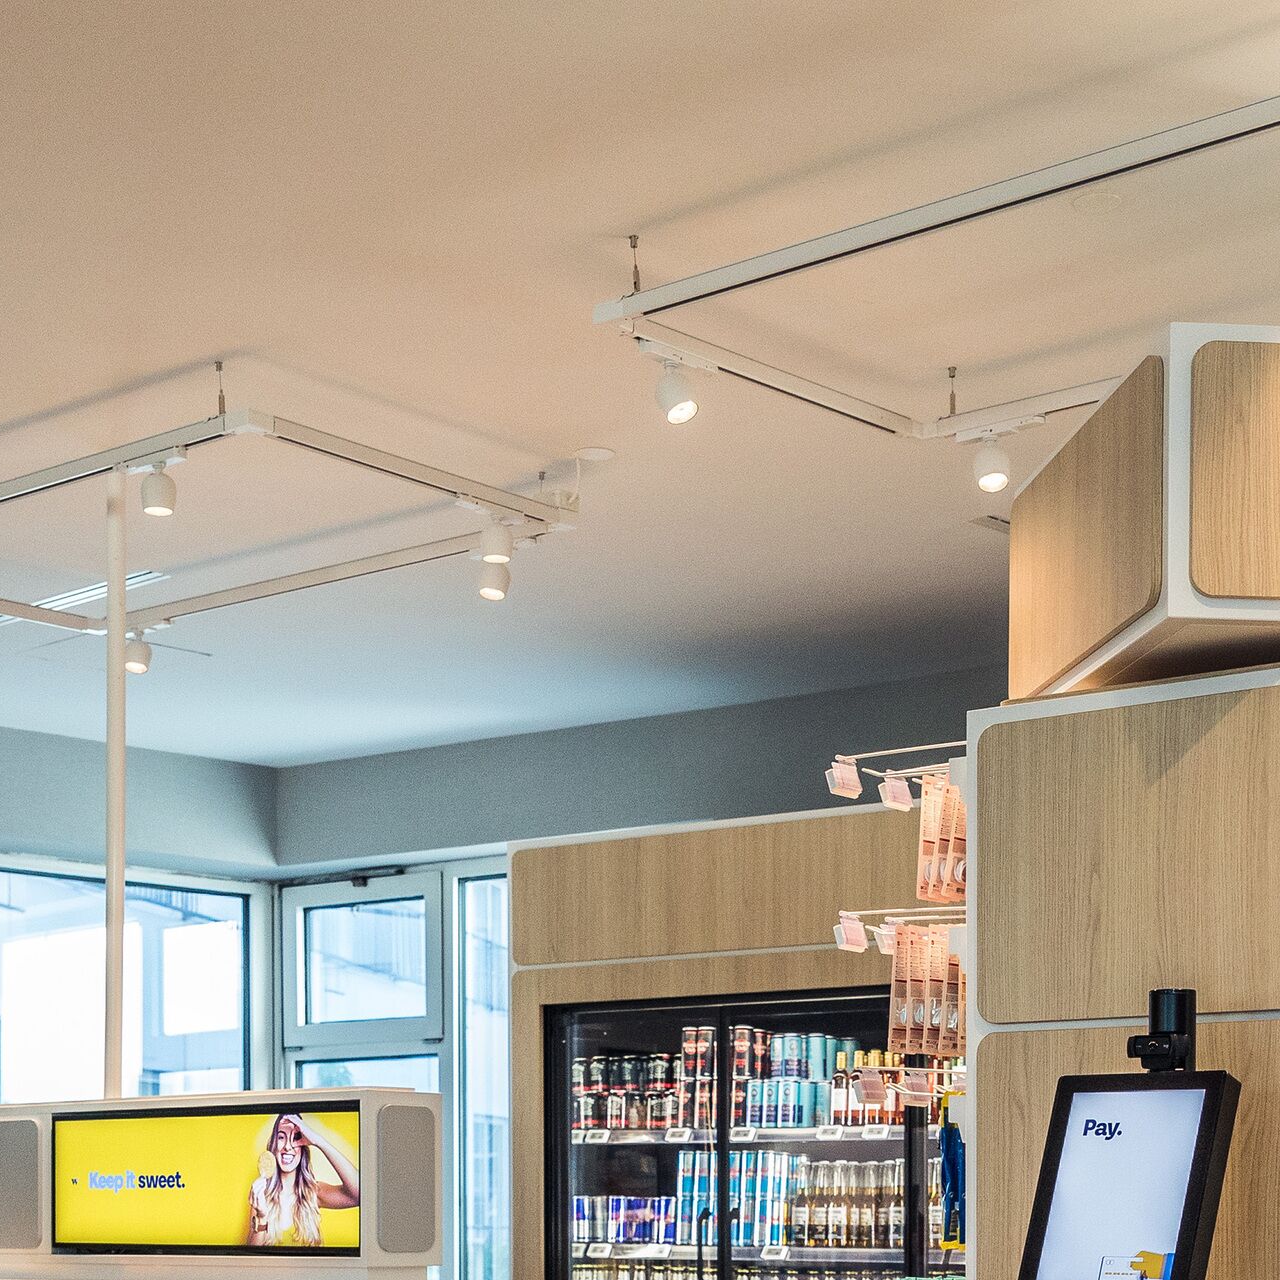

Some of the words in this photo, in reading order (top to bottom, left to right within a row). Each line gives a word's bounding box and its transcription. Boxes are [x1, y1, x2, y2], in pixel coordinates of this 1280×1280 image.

[1082, 1117, 1123, 1140] Pay.
[88, 1170, 124, 1193] Keep
[125, 1170, 136, 1189] it
[137, 1170, 185, 1189] sweet.
